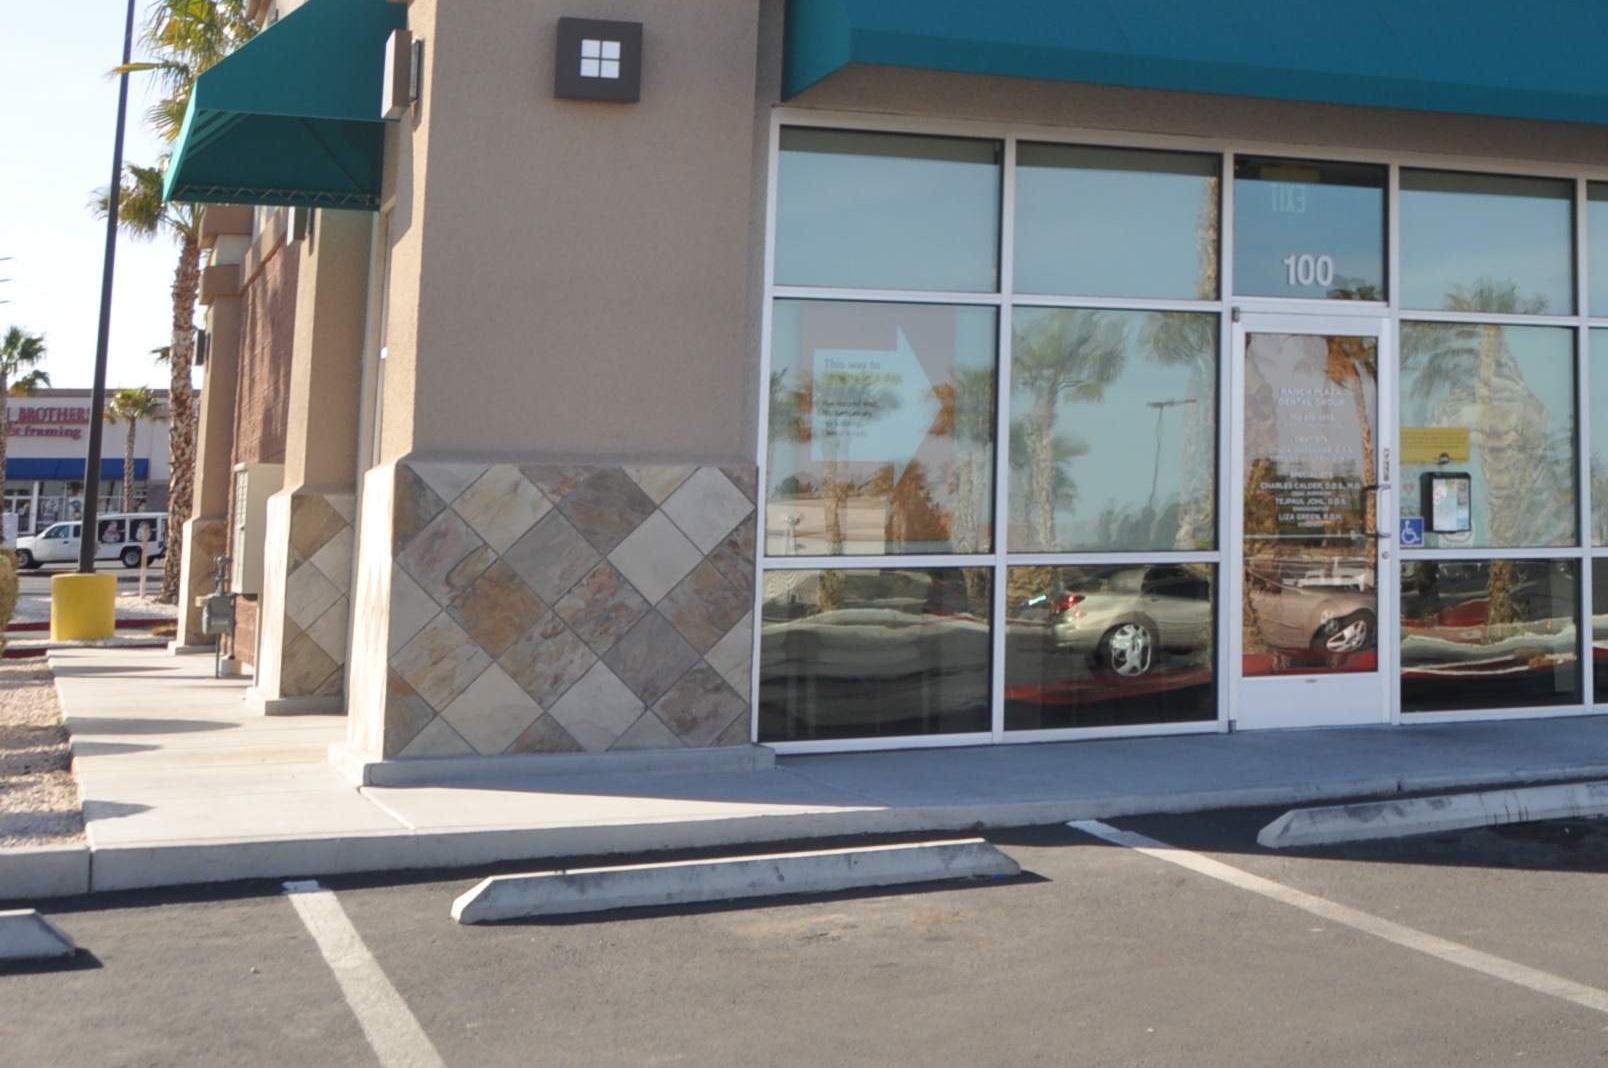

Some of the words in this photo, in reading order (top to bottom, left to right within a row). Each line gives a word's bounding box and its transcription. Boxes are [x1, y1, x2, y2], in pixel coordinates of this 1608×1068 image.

[1282, 254, 1334, 286] 100
[824, 359, 845, 370] This
[848, 361, 866, 372] way
[870, 360, 880, 370] to
[1280, 388, 1312, 397] RANCH
[1314, 388, 1342, 397] PLAZA
[1278, 397, 1311, 407] DENTAL
[1315, 397, 1345, 407] GROUP
[25, 425, 82, 440] framing
[1290, 471, 1333, 479] SPECIALISTS
[1261, 482, 1292, 490] CHARLES
[1278, 513, 1294, 521] LIZA
